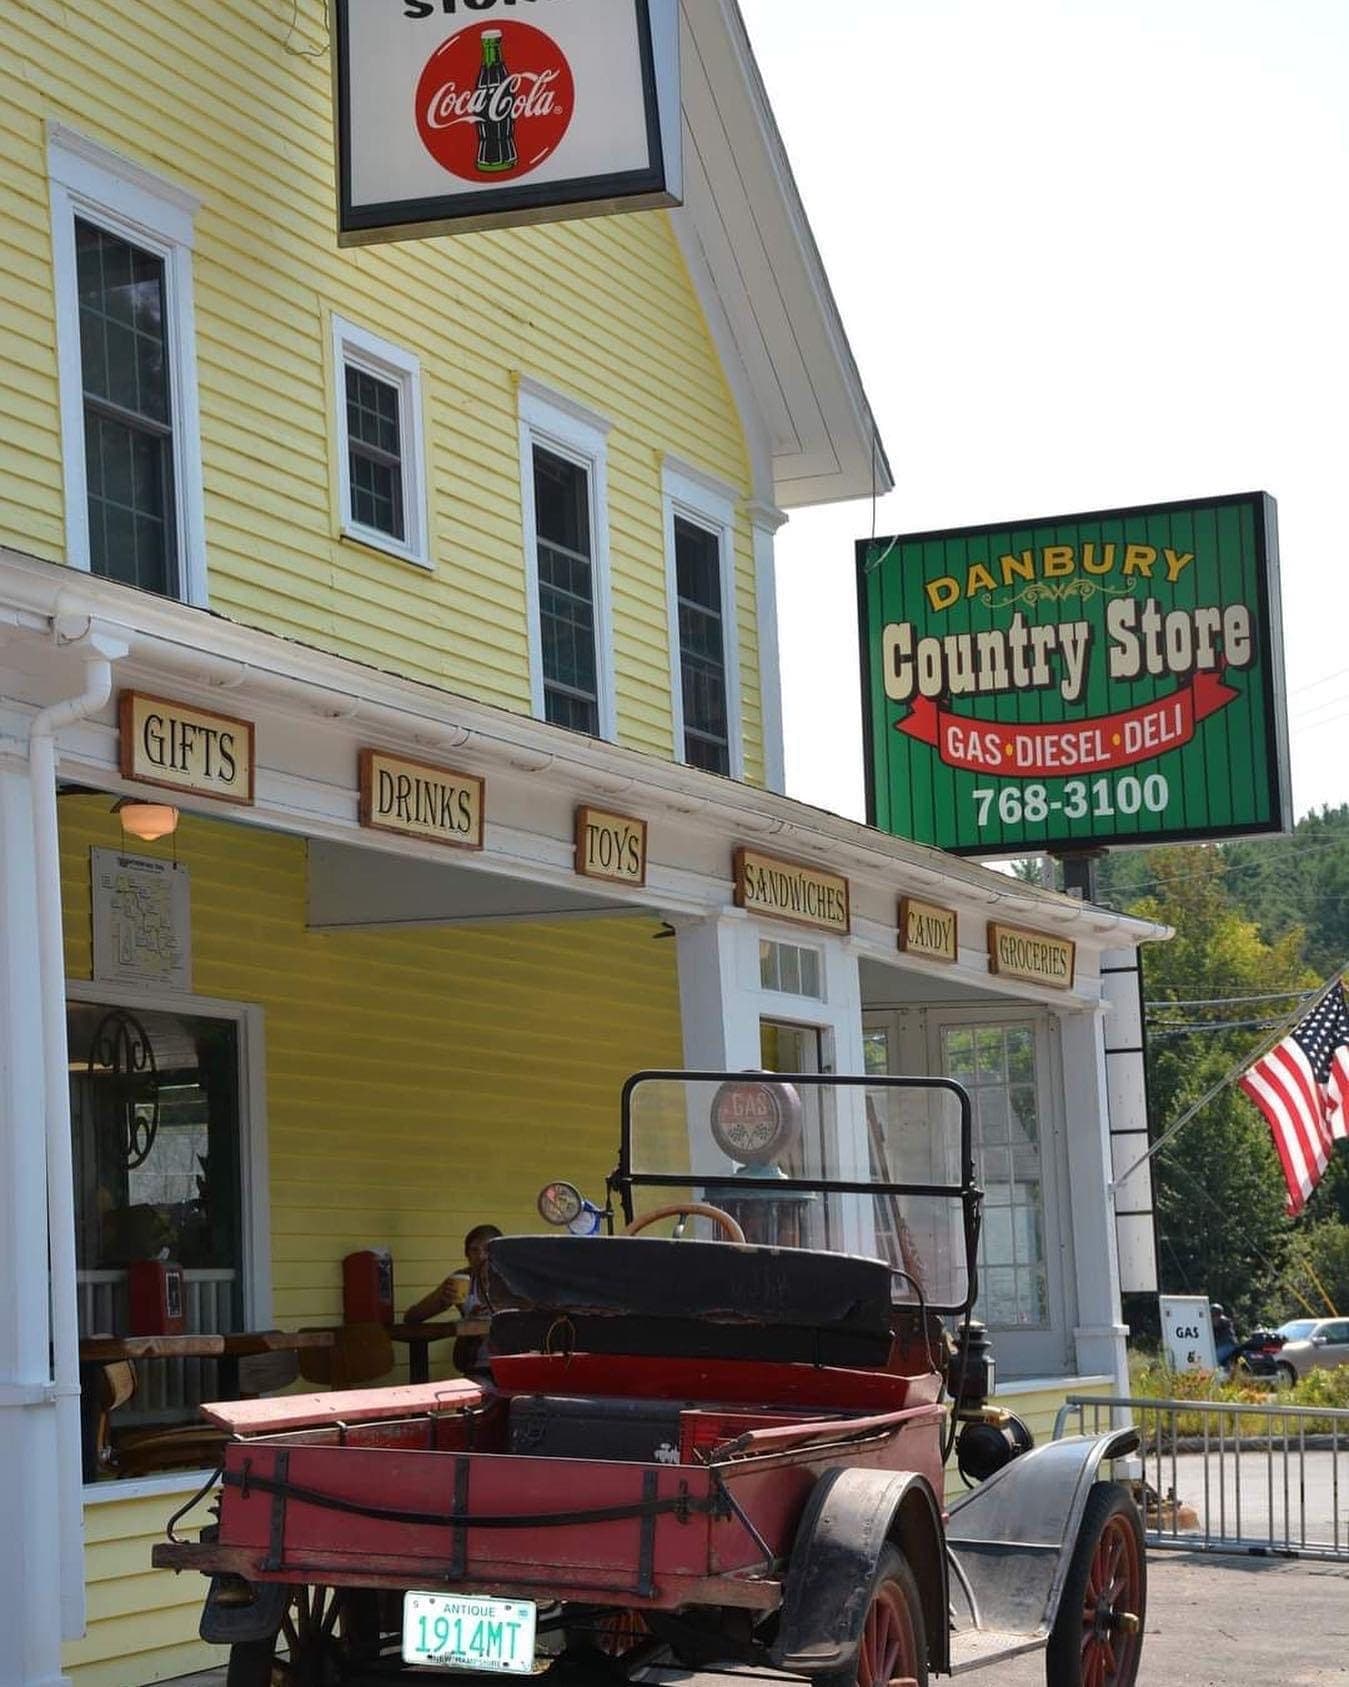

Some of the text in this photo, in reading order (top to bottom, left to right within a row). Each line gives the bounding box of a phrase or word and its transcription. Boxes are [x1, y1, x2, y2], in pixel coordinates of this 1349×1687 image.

[426, 69, 560, 129] Coca-Cola
[925, 543, 1196, 613] DANBURY
[882, 597, 1252, 701] Country Store
[143, 713, 237, 783] GIFTS
[946, 703, 1184, 768] GAS DIESEL DELI
[378, 768, 473, 834] DRINKS
[972, 774, 1170, 827] 768-3100
[587, 824, 639, 874] TOYS
[744, 863, 845, 922] SANDWICHES
[907, 911, 952, 951] CANDY
[1000, 934, 1067, 976] GROCERIES
[733, 1092, 768, 1116] GAS
[1175, 1326, 1200, 1339] GAS
[415, 1615, 521, 1659] 1914MT
[444, 1604, 496, 1617] ANTIQUE
